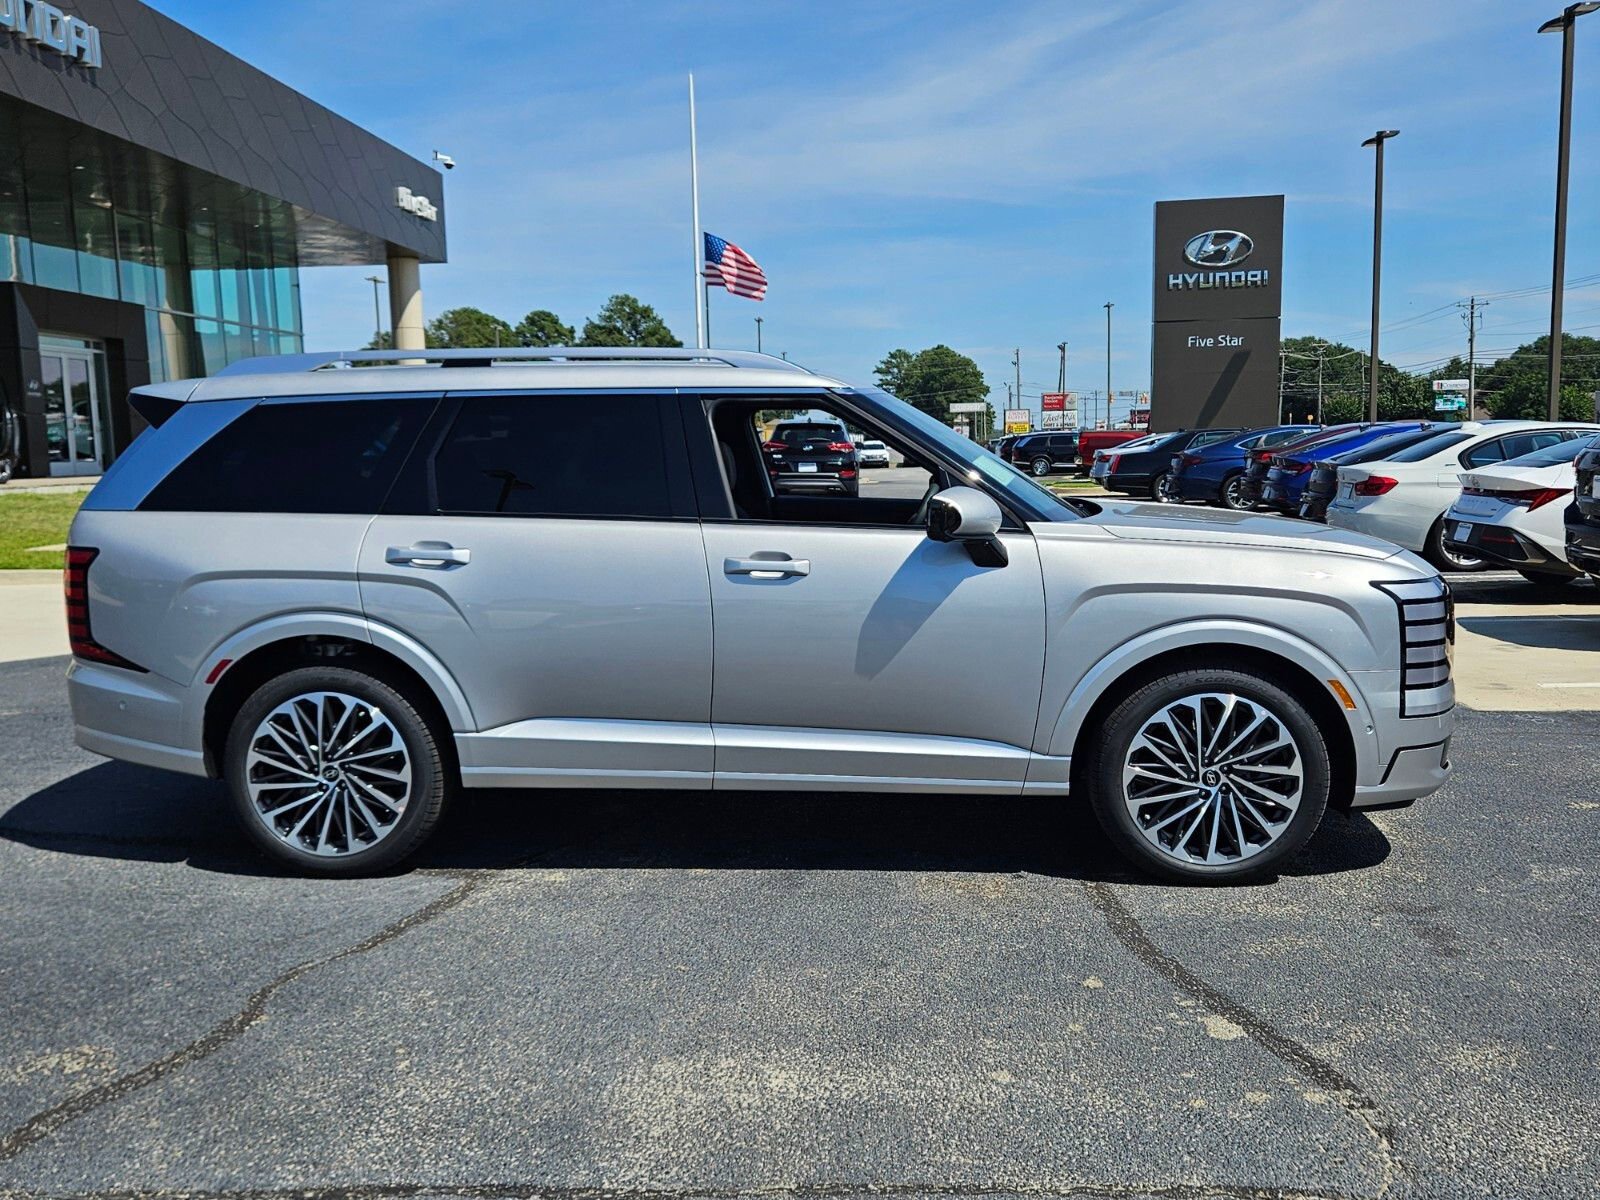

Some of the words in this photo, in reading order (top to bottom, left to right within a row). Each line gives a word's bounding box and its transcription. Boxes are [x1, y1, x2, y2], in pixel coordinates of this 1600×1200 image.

[1168, 269, 1269, 290] HYUNDAI
[1187, 335, 1214, 347] Five
[1217, 334, 1245, 347] Star
